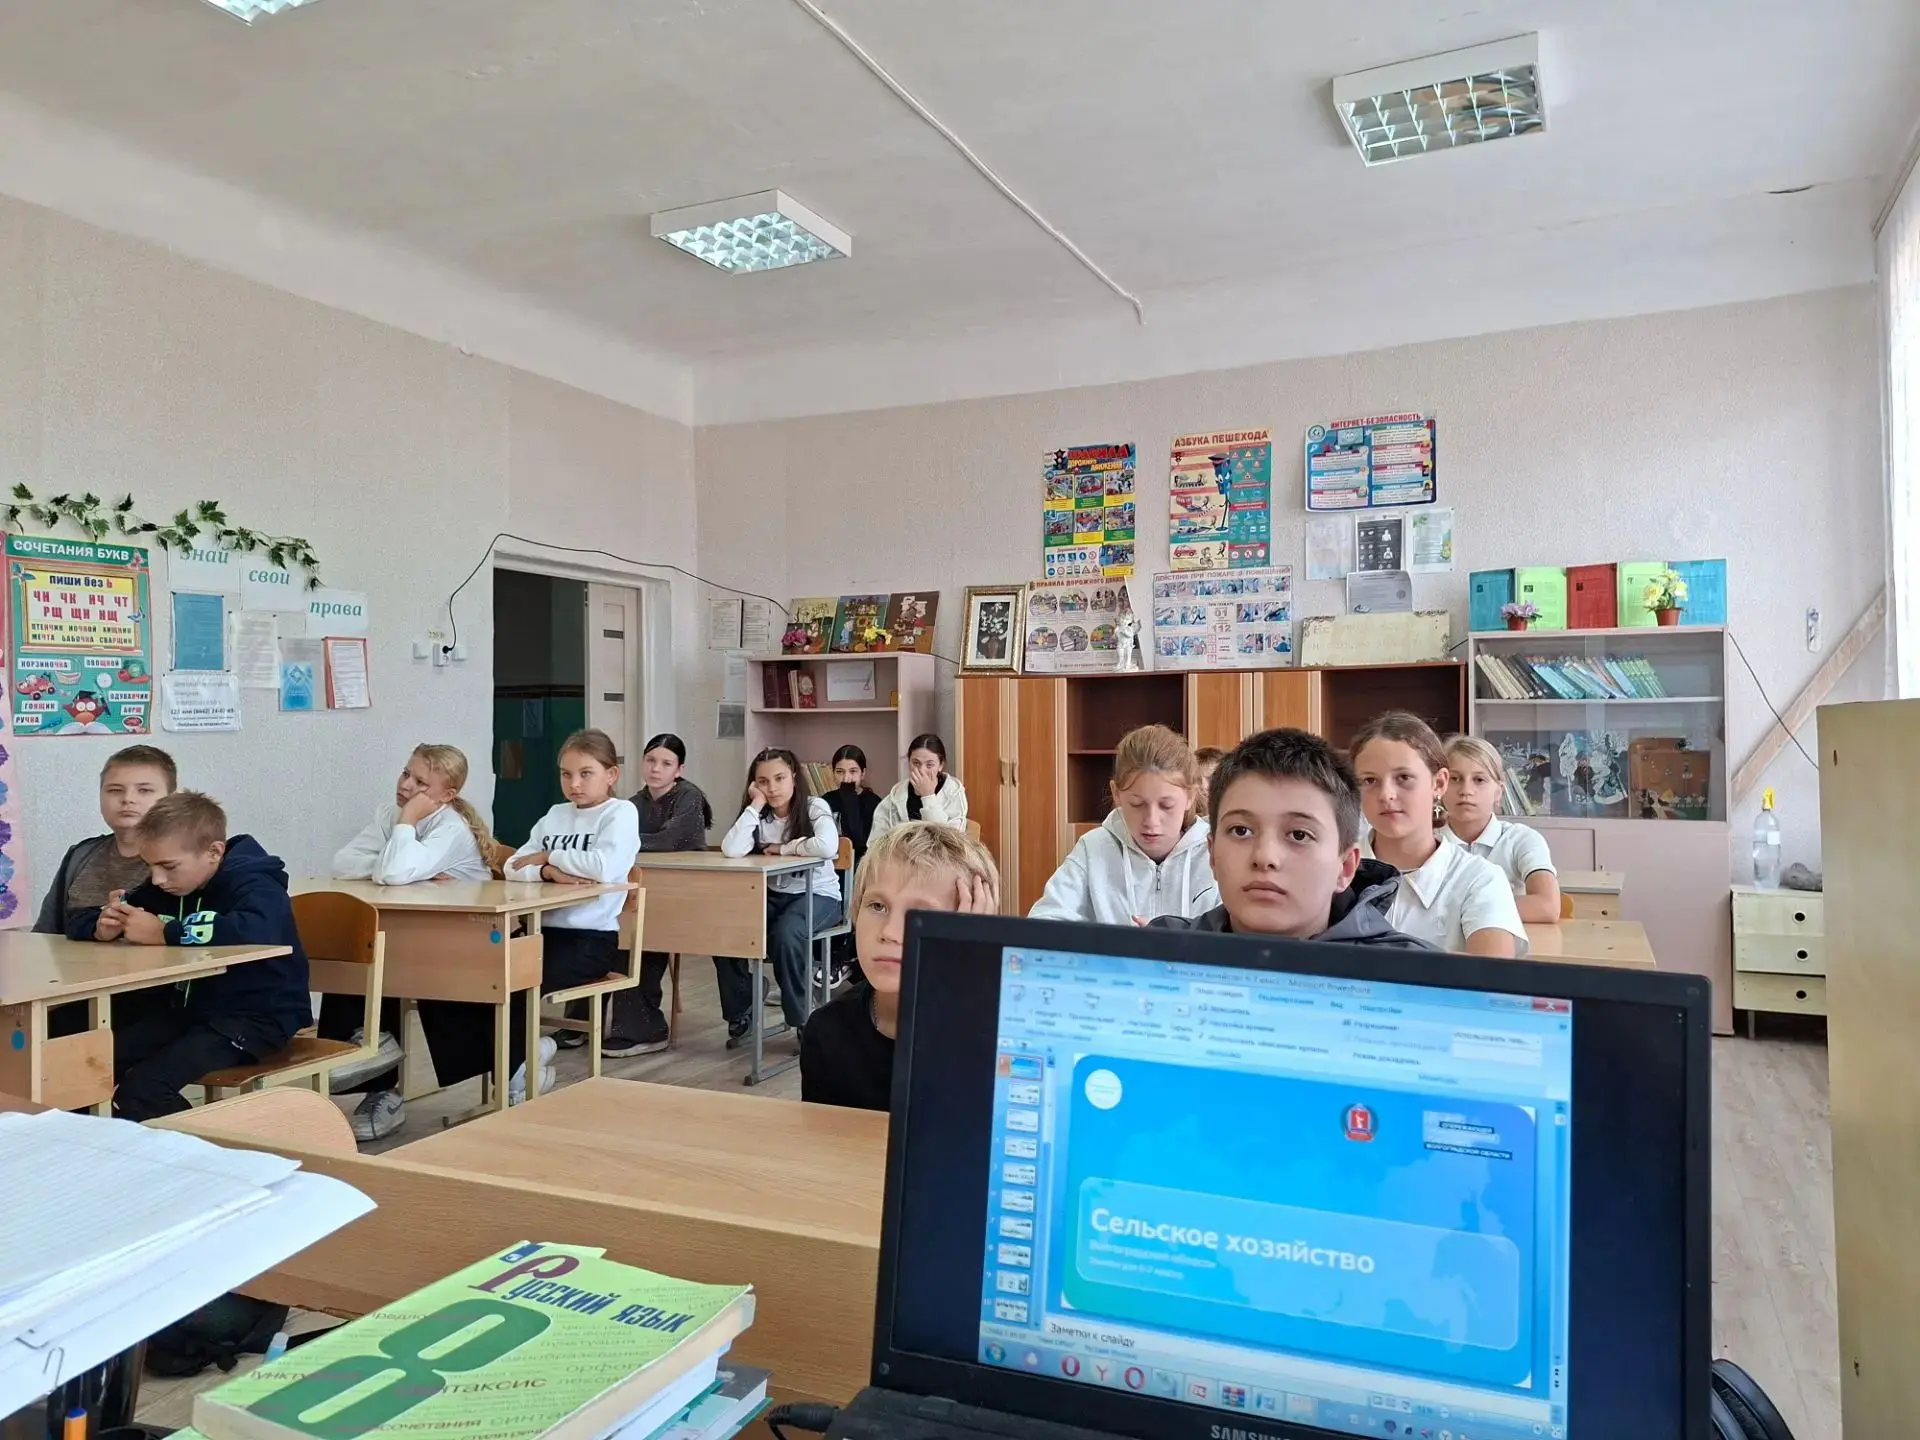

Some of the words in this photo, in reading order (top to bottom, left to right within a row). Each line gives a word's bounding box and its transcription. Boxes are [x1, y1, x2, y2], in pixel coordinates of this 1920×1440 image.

[1174, 435, 1210, 447] АЗБУКА
[1212, 430, 1268, 444] ПЕШЕХОДА
[13, 540, 94, 557] СОЧЕТАНИЯ
[97, 548, 130, 561] БУКВ
[49, 575, 81, 586] пиши
[84, 576, 104, 588] без
[249, 569, 290, 585] свои
[33, 590, 50, 603] ЧН
[114, 596, 128, 607] ЧТ
[43, 606, 63, 619] РЩ
[310, 600, 362, 618] права
[1212, 624, 1232, 633] 112
[1090, 1207, 1219, 1250] Сельское
[1225, 1233, 1376, 1274] хозяйство
[467, 1254, 622, 1316] Русский
[609, 1303, 696, 1334] язык
[1049, 1322, 1092, 1342] Заметки
[1092, 1332, 1099, 1341] к
[1100, 1331, 1136, 1349] слайду
[246, 1299, 553, 1440] 8
[1210, 1424, 1292, 1440] SAMSU
